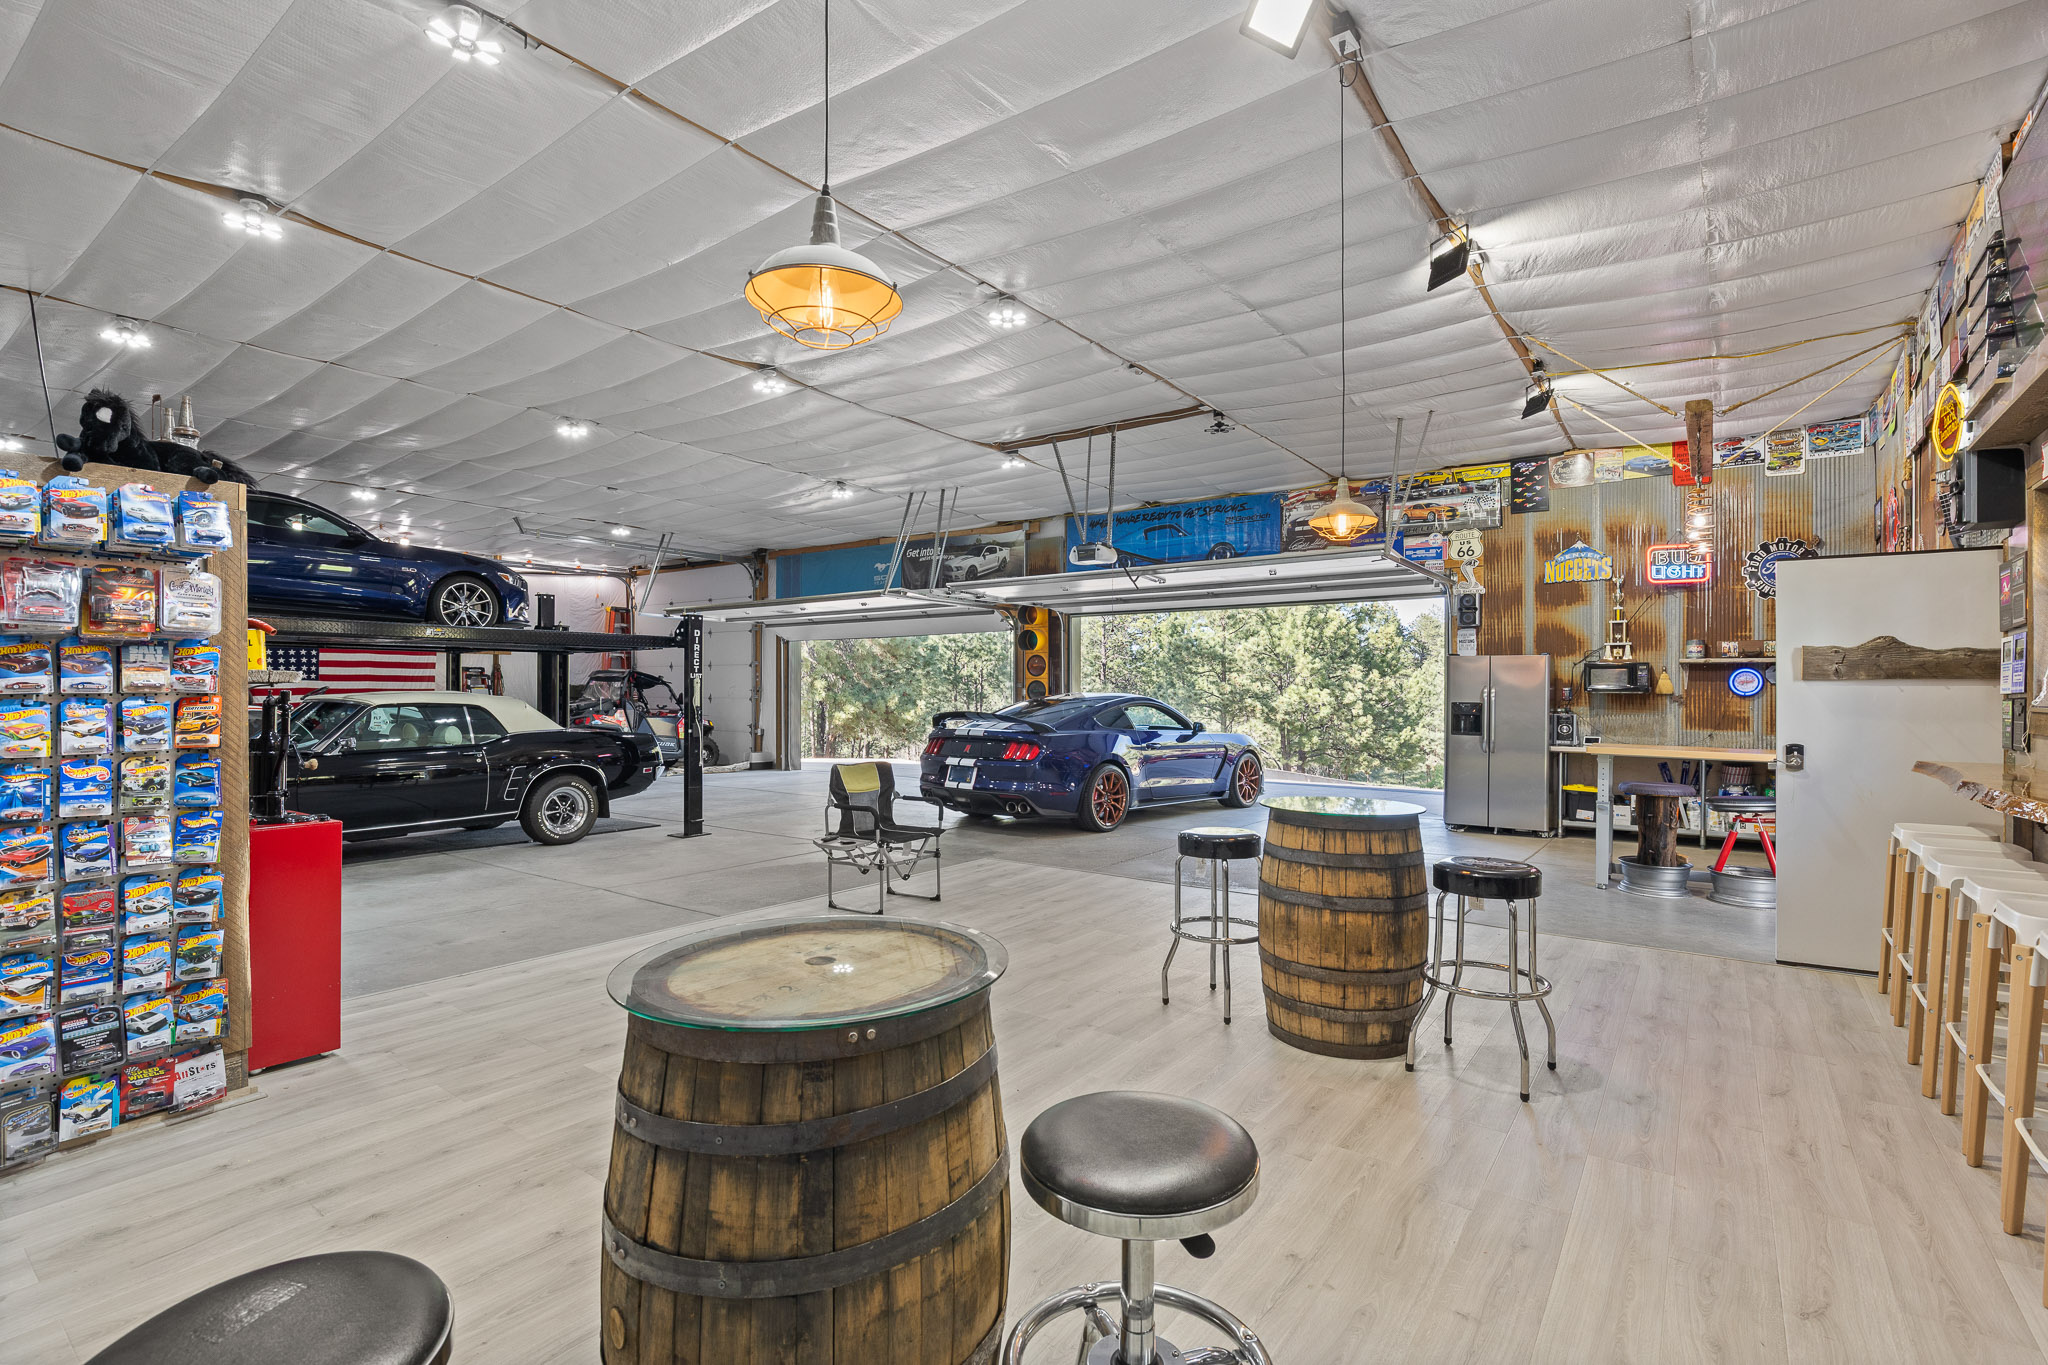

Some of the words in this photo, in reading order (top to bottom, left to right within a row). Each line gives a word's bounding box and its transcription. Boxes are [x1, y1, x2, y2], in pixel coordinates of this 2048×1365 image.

[1809, 449, 1861, 457] MUSTANG
[1455, 531, 1475, 539] ROUTE
[906, 548, 920, 558] Get
[920, 547, 934, 557] into
[1457, 545, 1475, 558] 66
[1557, 552, 1601, 563] DENVER
[1749, 550, 1767, 572] FORD
[1769, 543, 1805, 555] MOTOR
[1545, 557, 1612, 583] NUGGETS
[1651, 565, 1706, 579] LIGHT
[693, 629, 701, 673] DIRECT
[128, 1070, 165, 1081] WHEELS
[131, 1067, 159, 1076] SPEED
